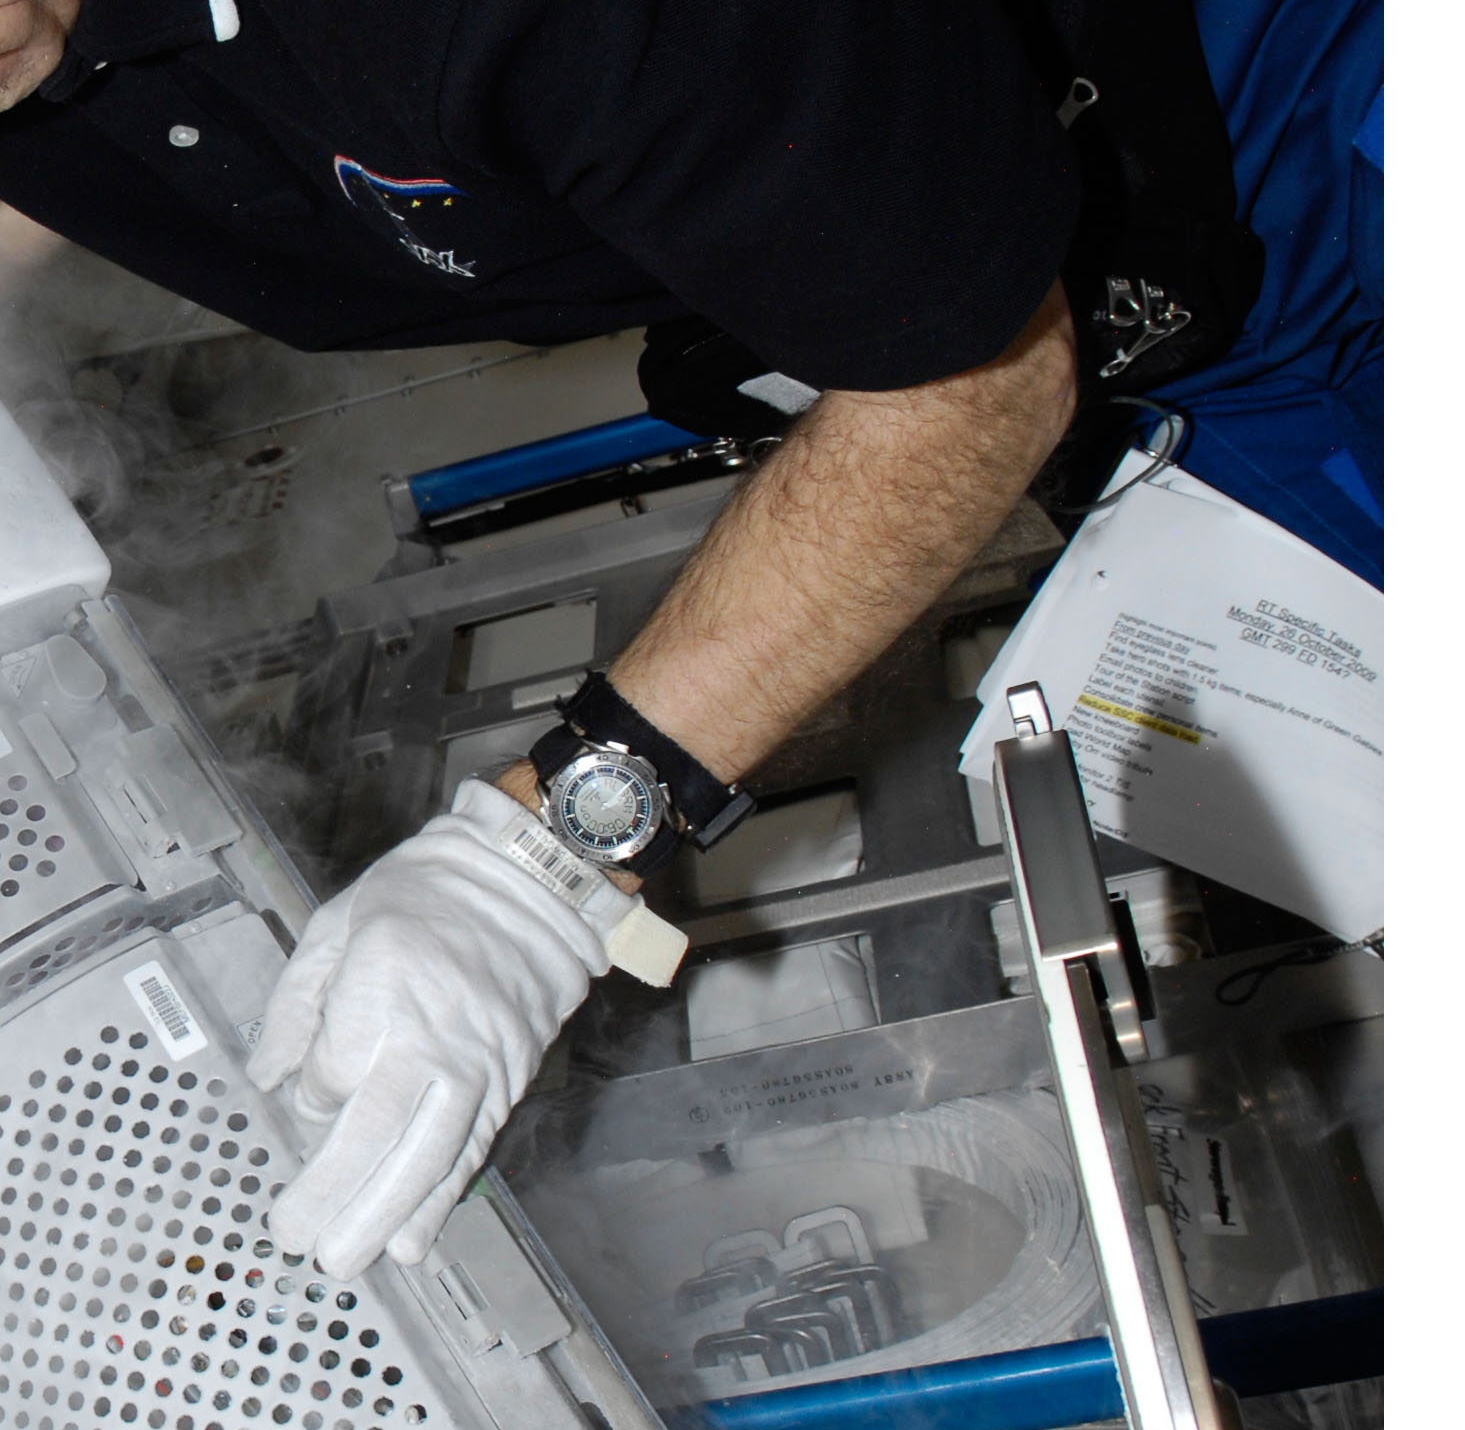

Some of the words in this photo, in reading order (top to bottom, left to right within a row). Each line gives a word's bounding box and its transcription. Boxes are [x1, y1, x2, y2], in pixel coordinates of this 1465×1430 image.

[1111, 620, 1137, 636] From
[1136, 630, 1173, 649] previous
[1173, 641, 1192, 655] day
[1239, 626, 1271, 647] GMT
[1271, 637, 1297, 656] 299
[1256, 598, 1277, 615] RT
[1276, 606, 1326, 638] Specific
[1326, 630, 1363, 658] Tasks
[1107, 630, 1129, 644] Find
[1127, 638, 1166, 658] eyeglass
[1167, 651, 1186, 664] lens
[1296, 631, 1346, 664] October
[1345, 658, 1378, 683] 2009
[1093, 664, 1115, 677] Tour
[1114, 671, 1125, 680] of
[1124, 674, 1140, 685] the
[1139, 679, 1173, 697] Station
[1097, 653, 1123, 667] Email
[1123, 662, 1153, 679] photos
[1153, 672, 1164, 682] to
[1087, 674, 1113, 689] Label
[1112, 683, 1135, 696] each
[1104, 642, 1126, 656] Take
[1127, 651, 1147, 663] hero
[1146, 657, 1171, 671] shots
[1172, 666, 1190, 678] with
[1191, 673, 1206, 683] 1.5
[1205, 677, 1218, 689] kg
[1244, 690, 1286, 712] especially
[1285, 705, 1311, 721] Anne
[1310, 714, 1323, 726] of
[1322, 718, 1352, 737] Green
[1071, 705, 1093, 718] New
[1092, 713, 1140, 735] kneeboard
[1077, 694, 1112, 713] Reduce
[1112, 706, 1134, 720] SSC
[1082, 684, 1134, 708] Consolidate
[1133, 703, 1156, 716] crew
[1155, 710, 1194, 730] personal
[1065, 714, 1094, 730] Photo
[1092, 723, 1126, 742] toolbox
[1084, 732, 1112, 748] World
[1111, 742, 1133, 757] Map
[1100, 750, 1126, 765] video
